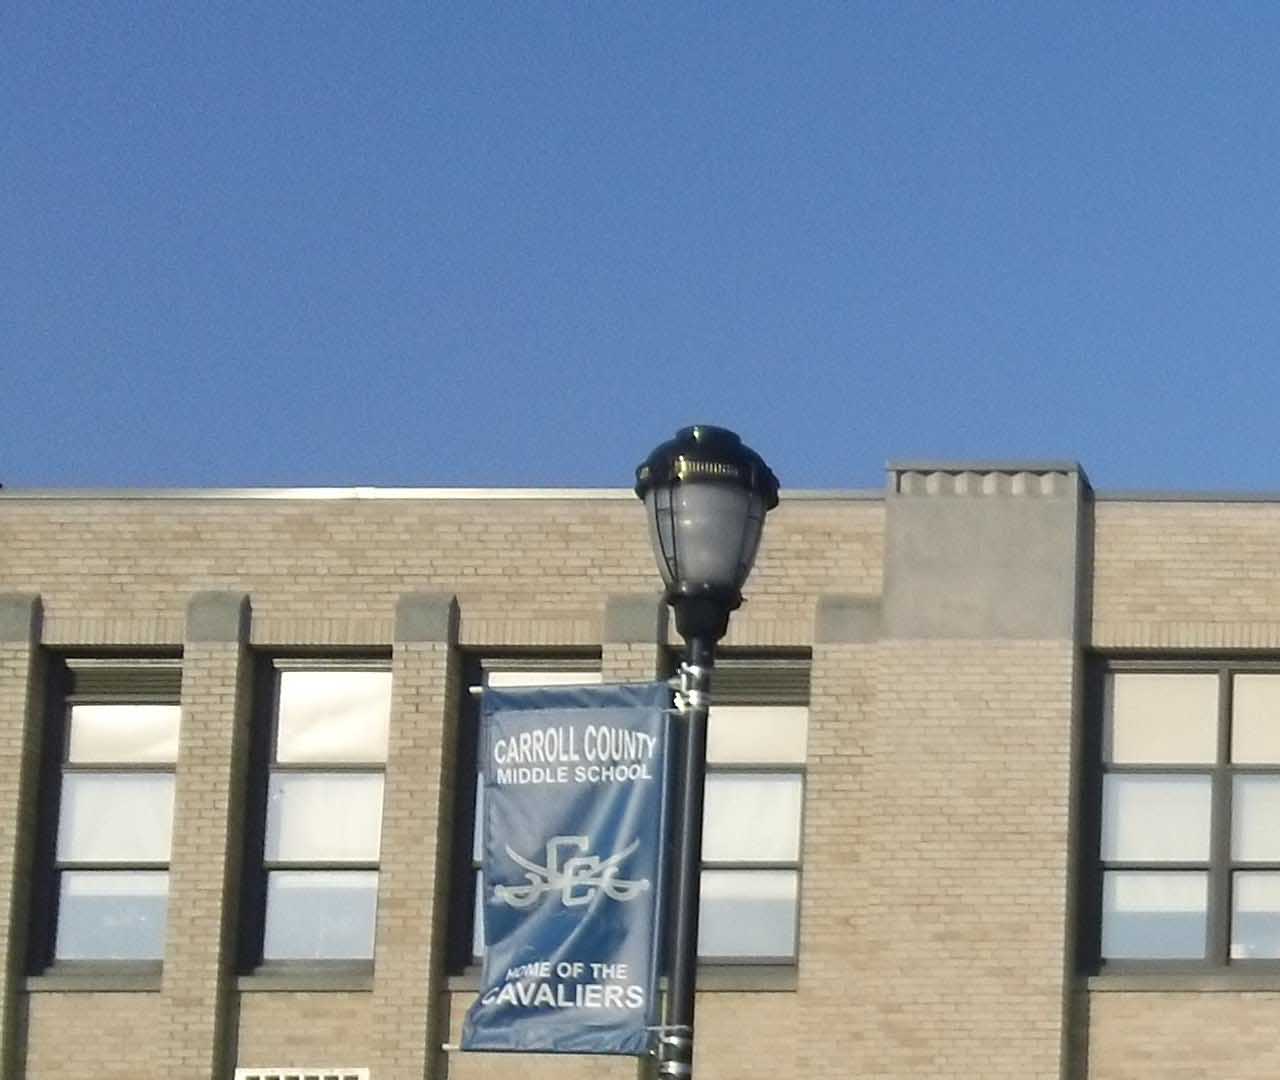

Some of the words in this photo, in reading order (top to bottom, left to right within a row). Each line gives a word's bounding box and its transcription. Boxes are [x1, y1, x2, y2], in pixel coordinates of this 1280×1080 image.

[494, 725, 580, 764] CARROLL
[583, 725, 657, 760] COUNTY
[497, 766, 569, 784] MIDDLE
[574, 764, 652, 783] SCHOOL
[505, 961, 551, 981] HOME
[556, 962, 584, 978] OF
[590, 963, 628, 979] THE
[481, 982, 644, 1008] CAVALIERS
